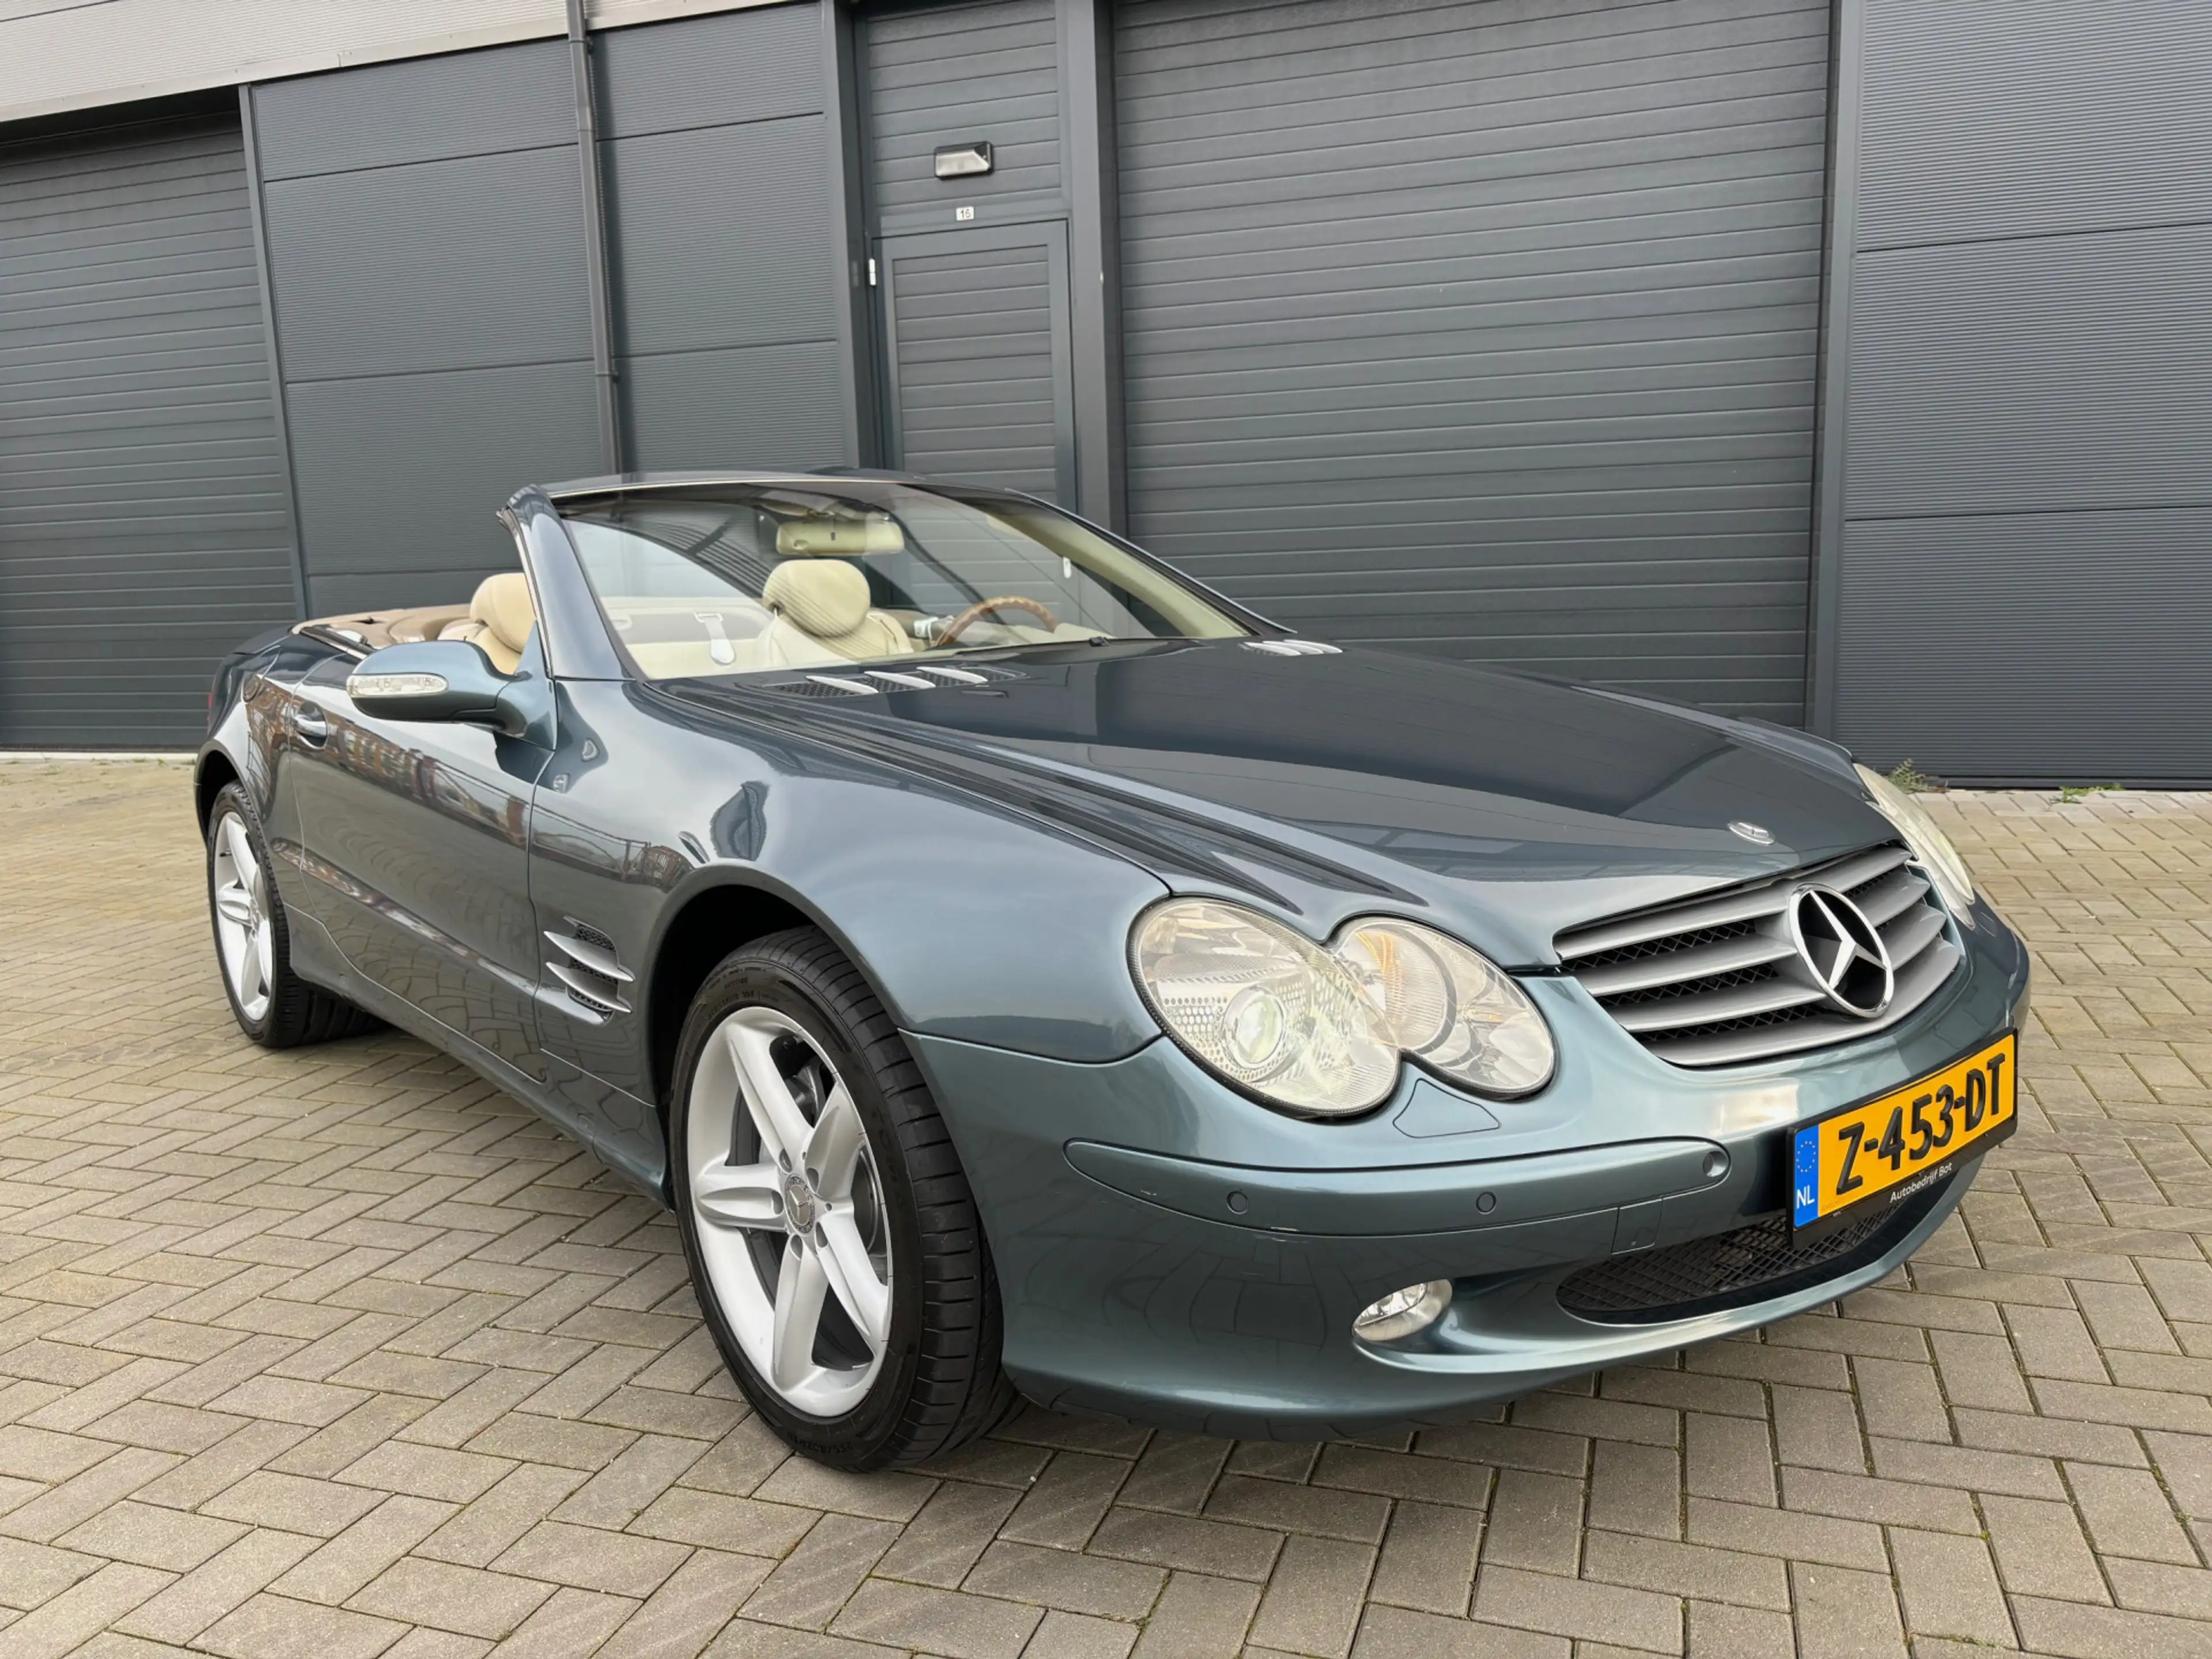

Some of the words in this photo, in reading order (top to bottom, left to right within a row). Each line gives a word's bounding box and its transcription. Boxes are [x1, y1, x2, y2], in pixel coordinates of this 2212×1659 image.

[960, 209, 971, 218] 16
[1836, 1052, 2005, 1195] Z-453-DT
[1797, 1184, 1815, 1209] NL
[1889, 1168, 1938, 1203] Autobedrijf
[1938, 1162, 1953, 1179] Bot
